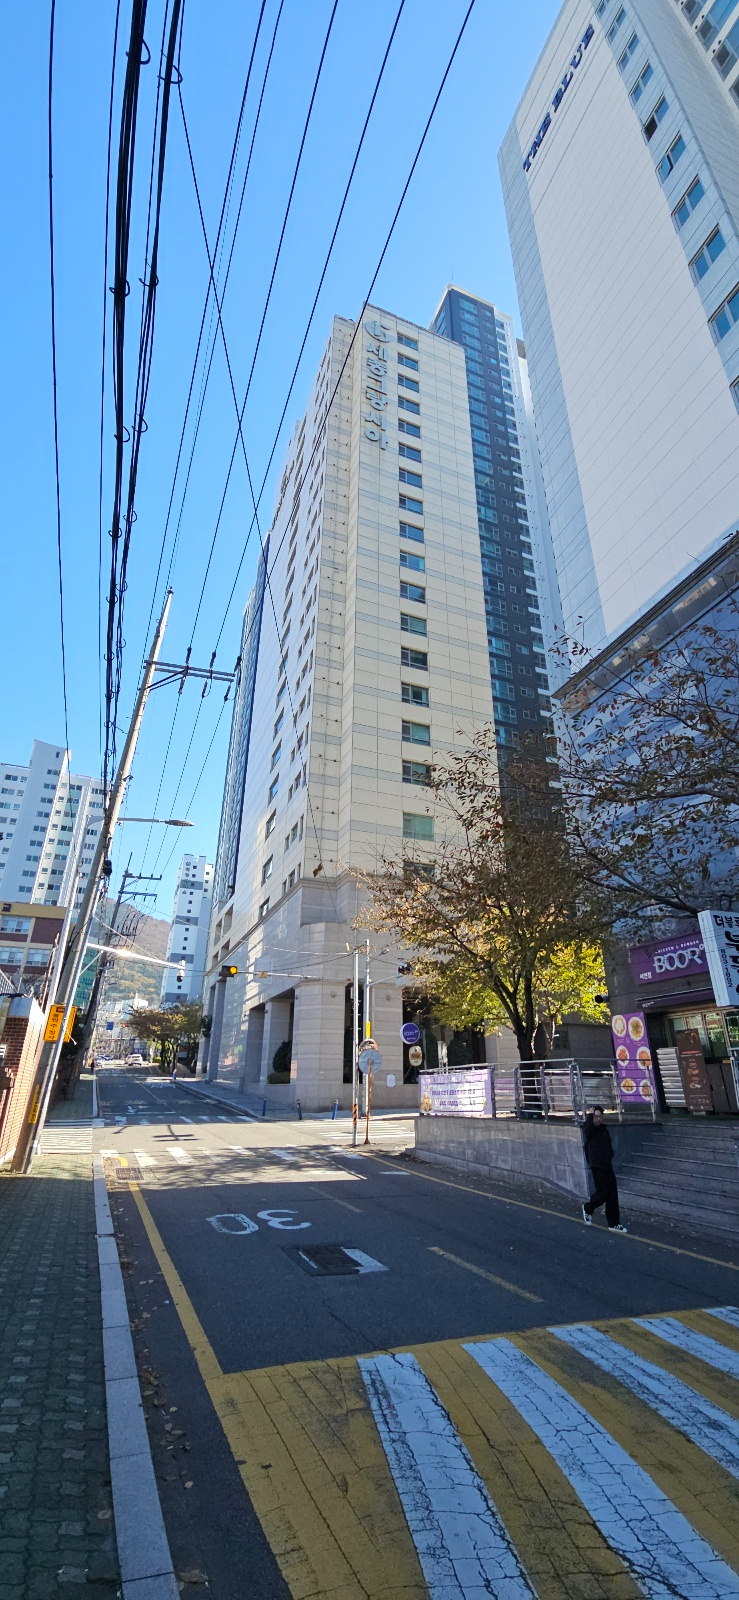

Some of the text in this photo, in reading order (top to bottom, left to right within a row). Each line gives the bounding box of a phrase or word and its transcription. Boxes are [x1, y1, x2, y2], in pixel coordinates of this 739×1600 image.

[522, 23, 595, 172] THE BLUE
[205, 1209, 312, 1235] 30
